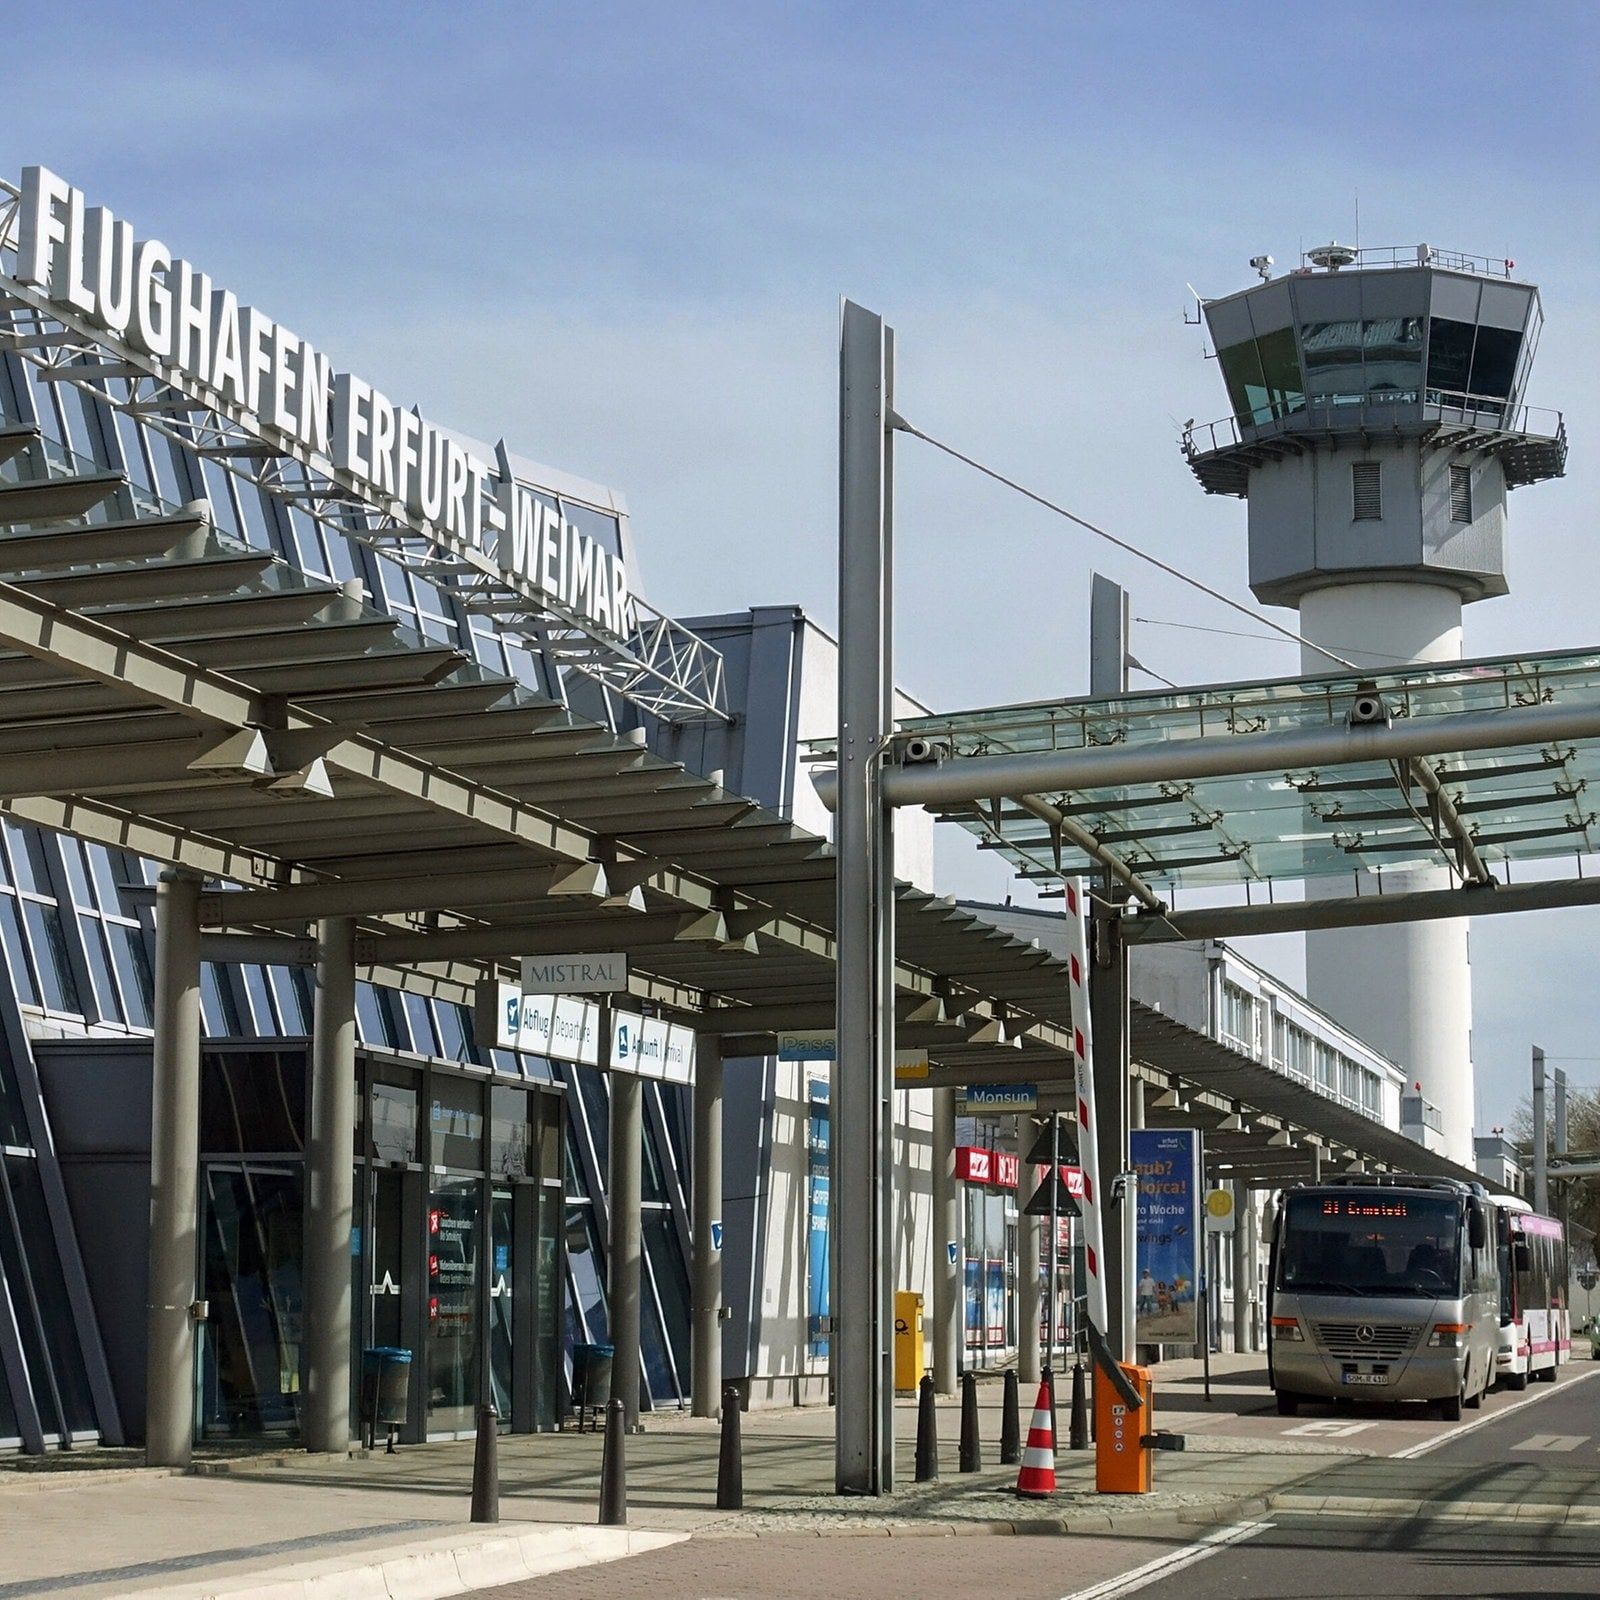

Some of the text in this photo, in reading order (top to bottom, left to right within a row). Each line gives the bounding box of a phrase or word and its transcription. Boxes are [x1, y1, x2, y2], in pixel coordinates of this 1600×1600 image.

[18, 165, 332, 452] FLUGHAFEN
[531, 963, 618, 984] MISTRAL
[523, 1007, 549, 1039] Abflug
[973, 1091, 1031, 1105] Monsun
[1149, 1204, 1185, 1214] Woche
